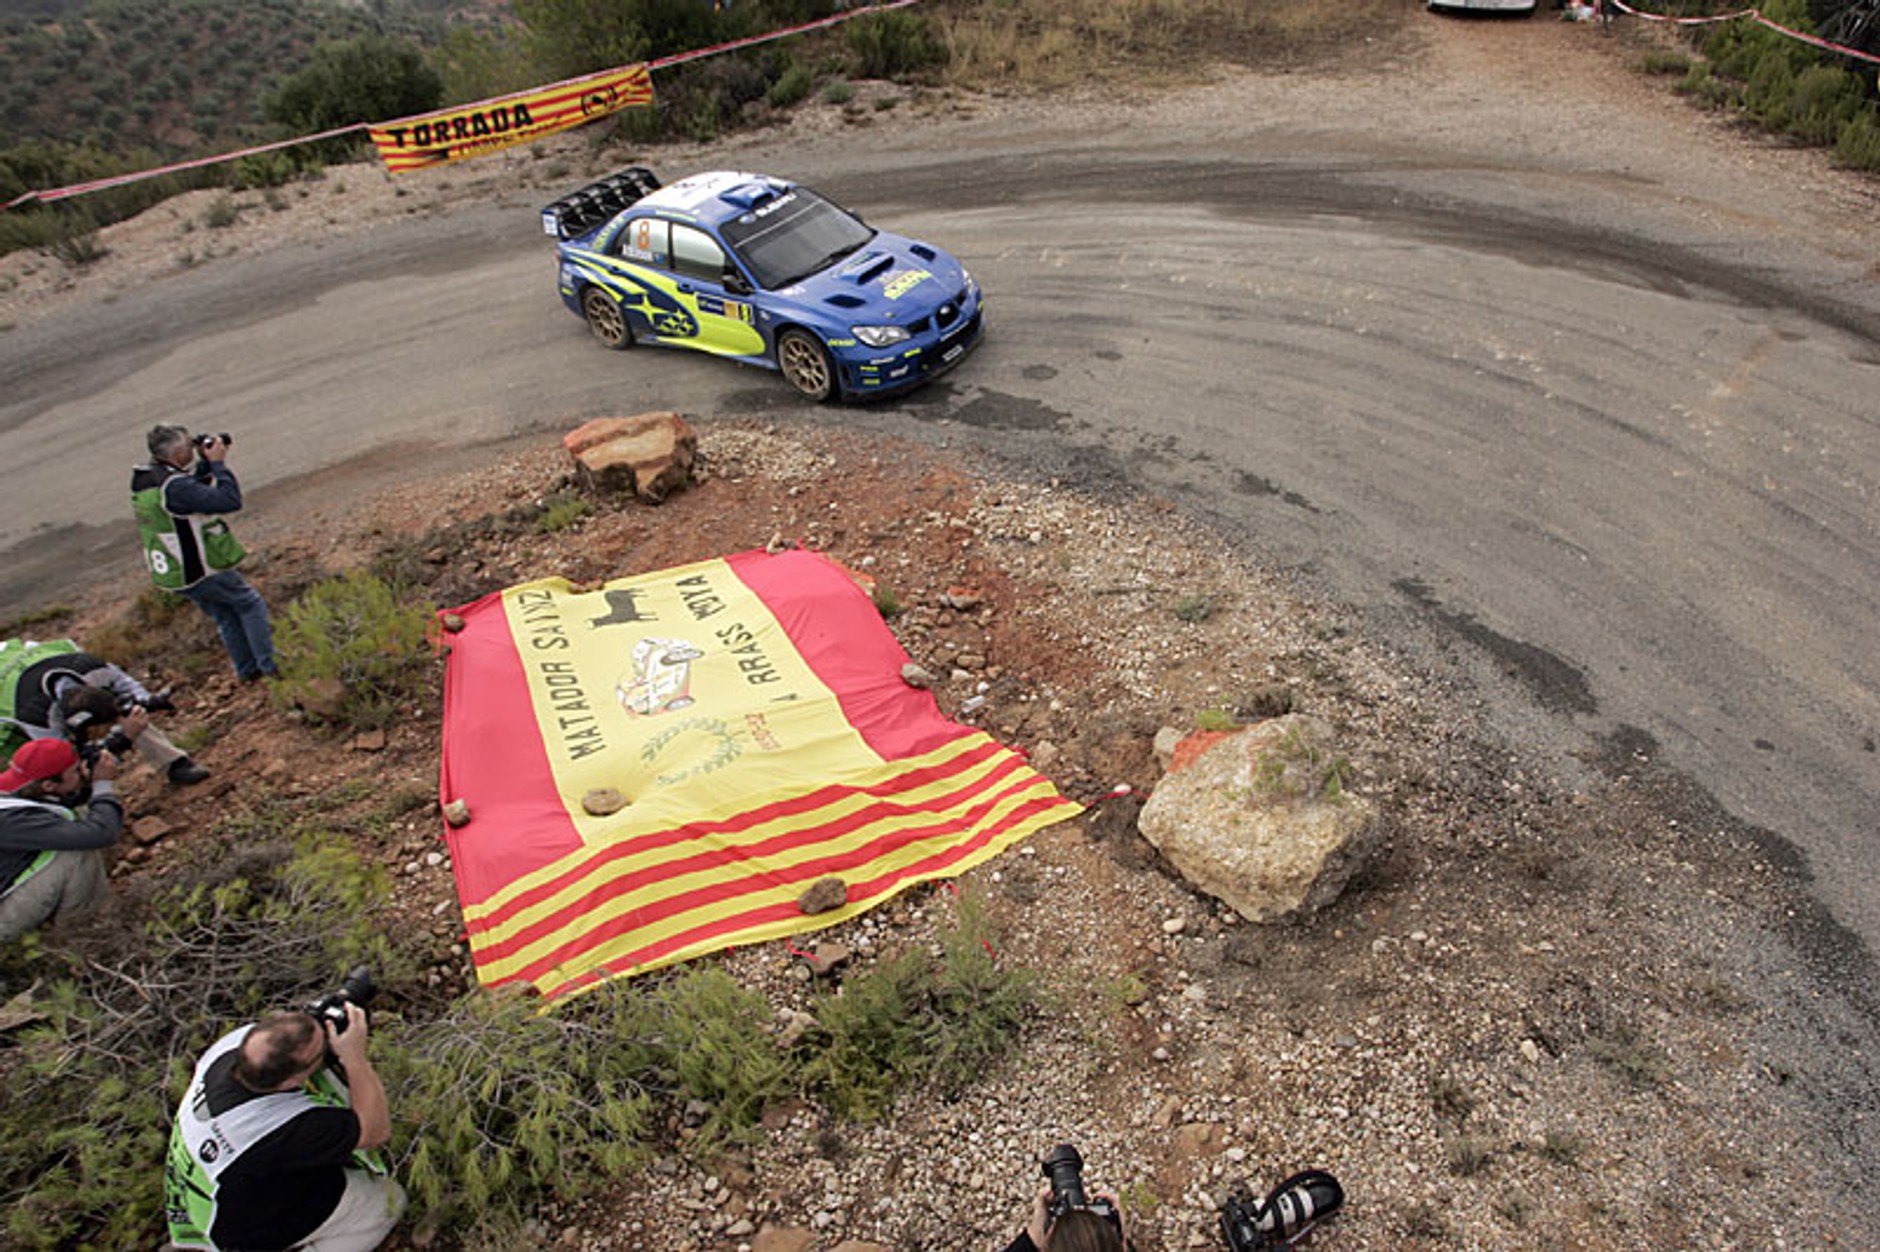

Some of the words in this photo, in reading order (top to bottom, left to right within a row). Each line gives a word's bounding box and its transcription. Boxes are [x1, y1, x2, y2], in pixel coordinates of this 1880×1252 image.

[386, 103, 534, 148] TORRADA
[637, 220, 650, 250] 8
[144, 547, 169, 574] 8
[675, 574, 727, 621] MOYA
[541, 662, 606, 760] MATADOR
